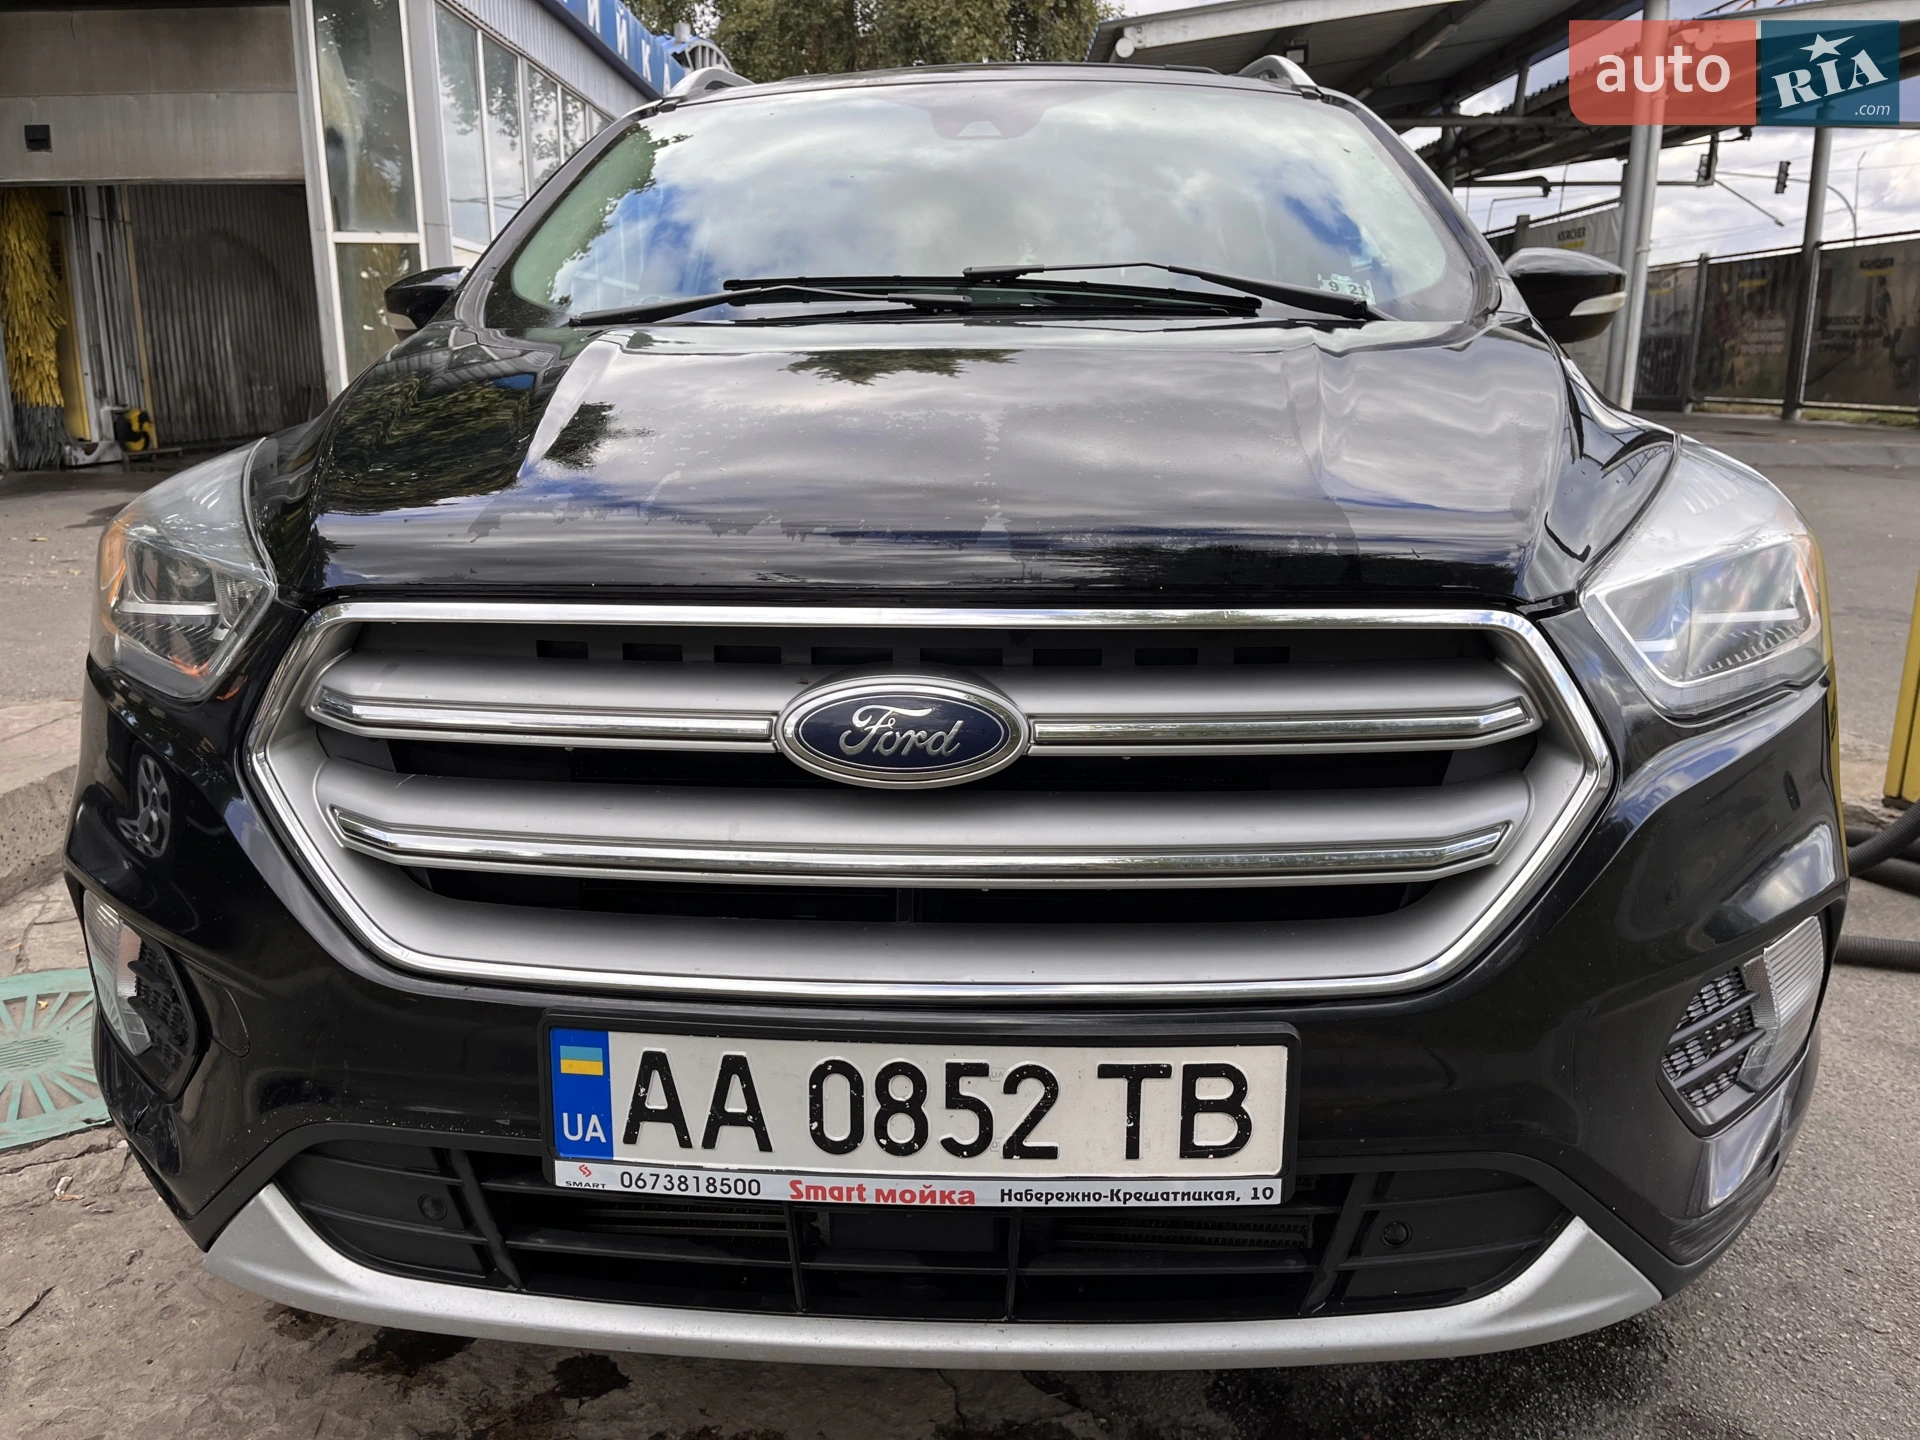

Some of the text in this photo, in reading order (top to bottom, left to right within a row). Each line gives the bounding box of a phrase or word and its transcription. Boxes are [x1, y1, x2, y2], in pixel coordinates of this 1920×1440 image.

[1328, 281, 1340, 292] 9
[838, 704, 964, 757] Ford
[622, 1049, 1253, 1160] AA 0852 TB
[562, 1112, 607, 1143] UA
[565, 1180, 607, 1189] SMART
[620, 1171, 761, 1196] 0673818500
[789, 1179, 976, 1205] Smart мойка
[1250, 1186, 1274, 1200] 10
